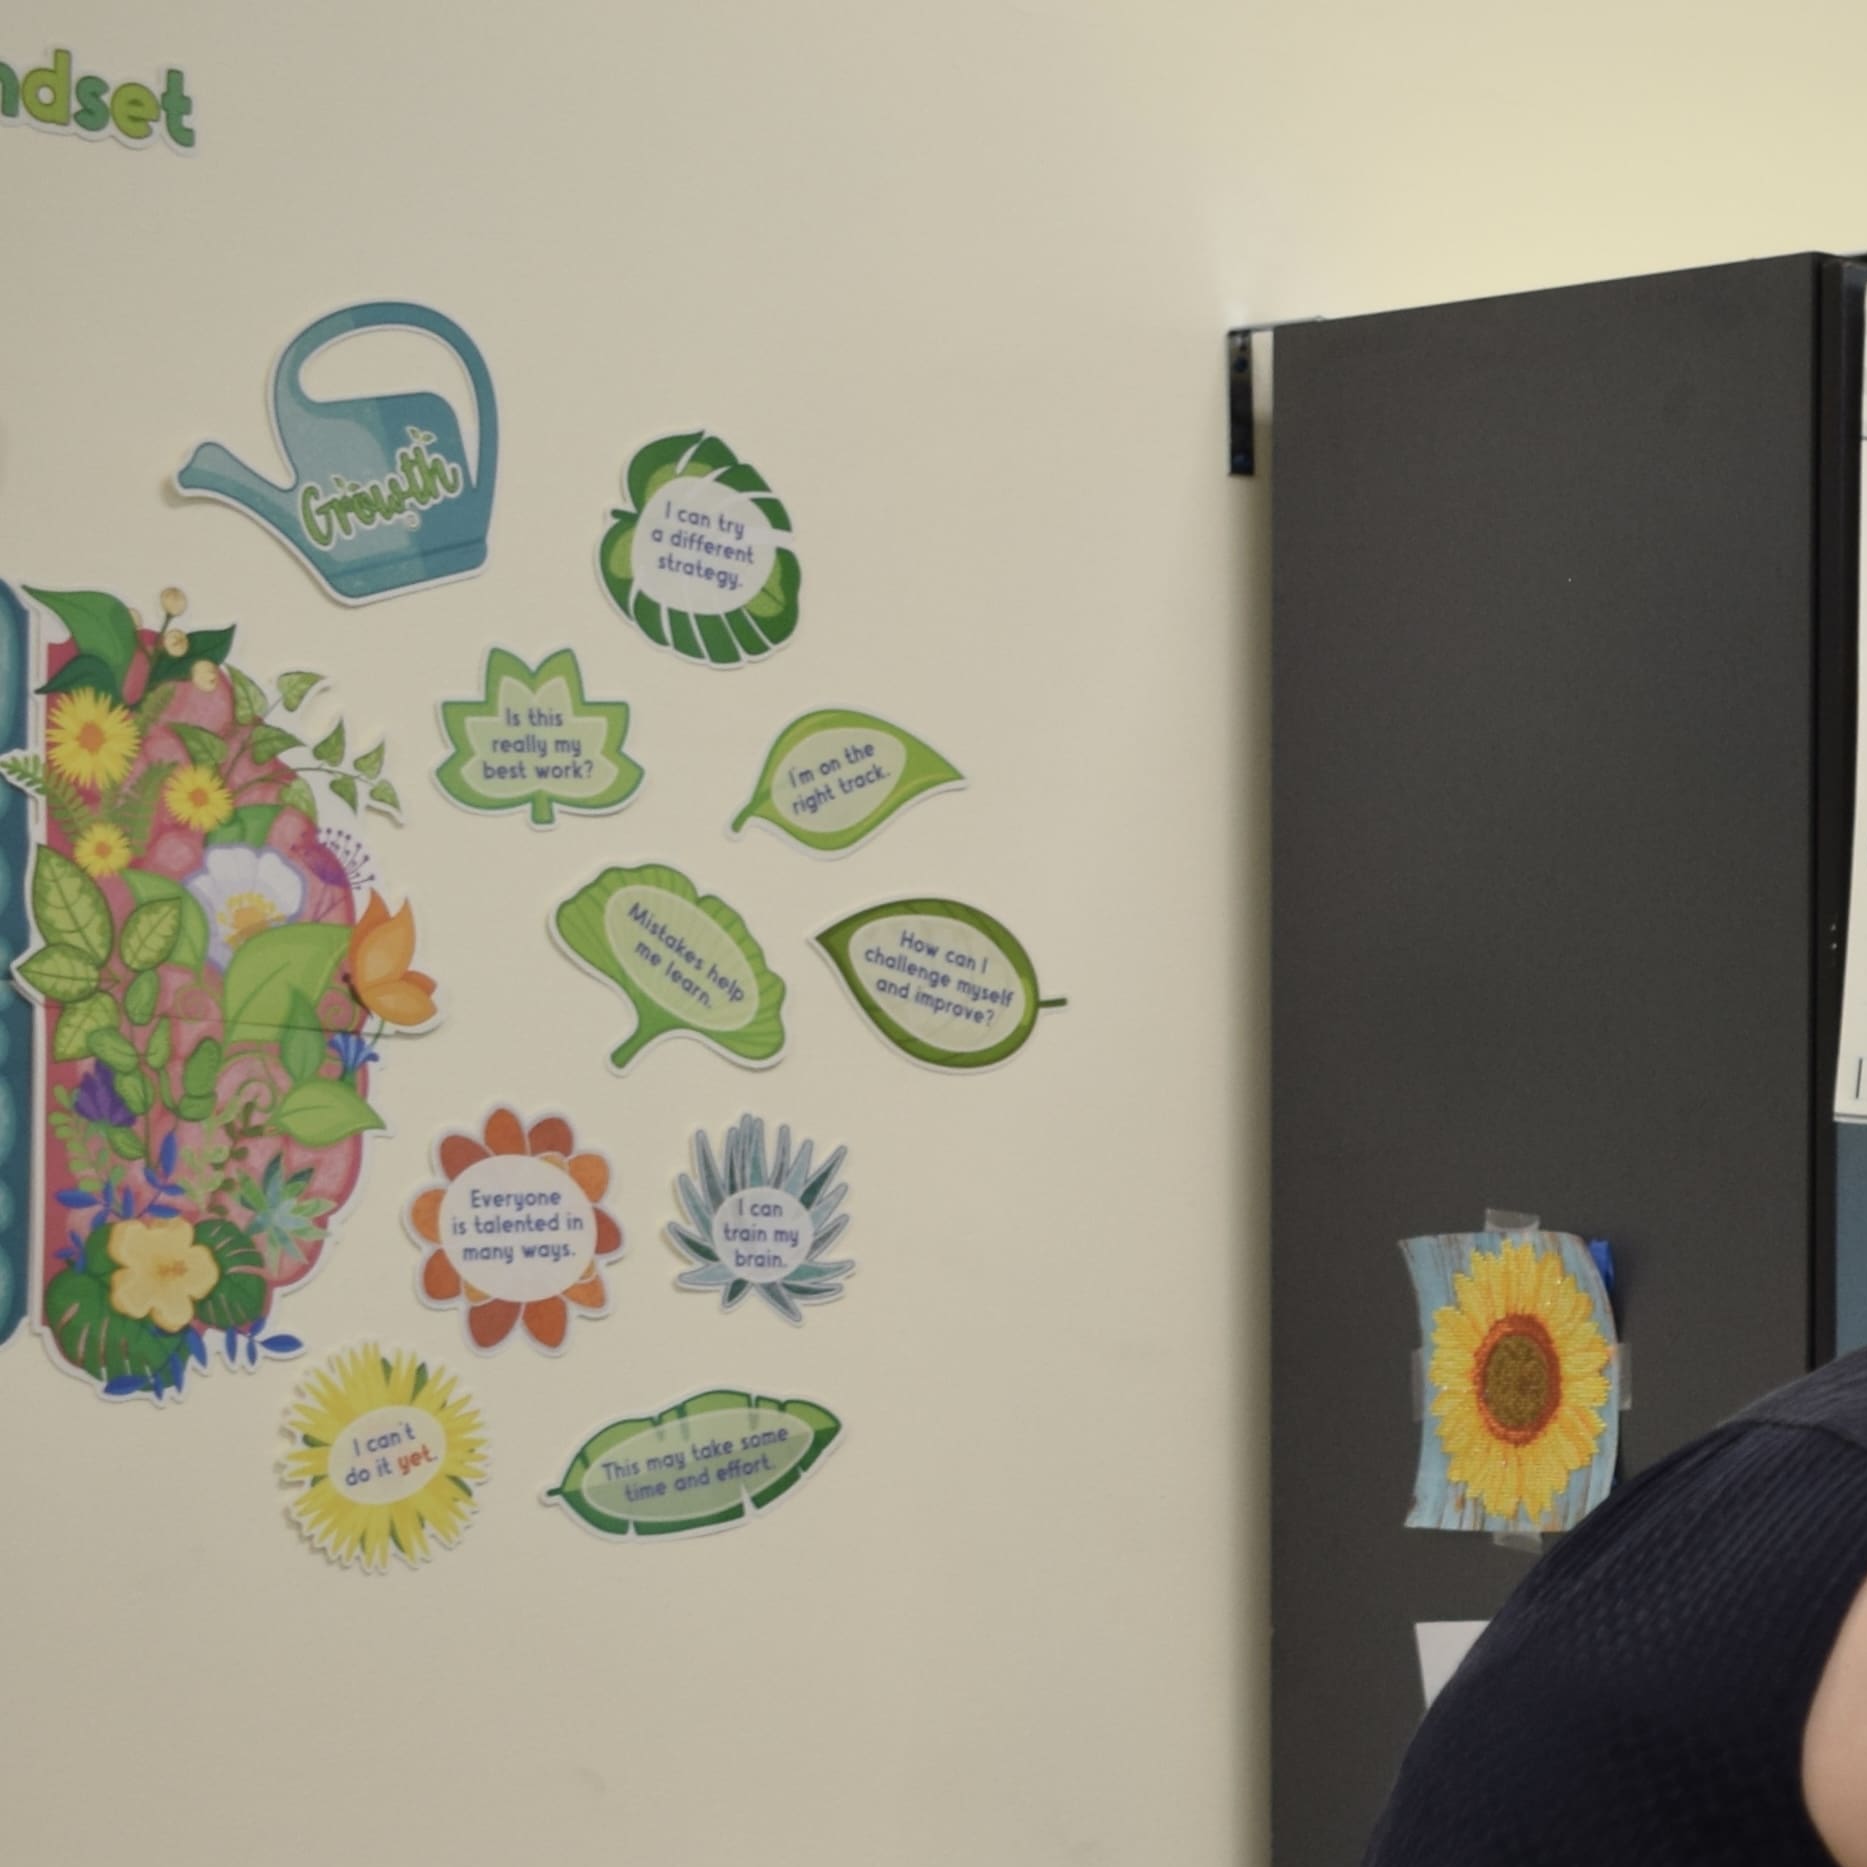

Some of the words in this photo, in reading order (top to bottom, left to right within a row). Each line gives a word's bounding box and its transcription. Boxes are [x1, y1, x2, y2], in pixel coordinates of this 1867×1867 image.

[299, 443, 463, 549] Growth
[664, 500, 672, 520] I
[678, 509, 711, 529] can
[718, 512, 745, 541] try
[651, 528, 664, 543] a
[670, 529, 754, 565] different
[657, 552, 743, 591] strategy.
[505, 707, 521, 728] Is
[527, 707, 564, 728] this
[491, 733, 548, 759] really
[554, 738, 582, 759] my
[818, 758, 841, 776] on
[843, 743, 875, 765] the
[482, 760, 527, 780] best
[535, 759, 594, 780] work?
[792, 783, 836, 816] right
[837, 763, 892, 795] track.
[627, 901, 706, 972] Mistakes
[706, 962, 746, 1003] help
[899, 929, 940, 958] How
[945, 950, 977, 971] can
[980, 956, 989, 975] I
[634, 941, 662, 967] me
[664, 960, 712, 1009] learn.
[863, 946, 952, 989] challenge
[956, 979, 1015, 1008] myself
[875, 979, 911, 999] and
[914, 985, 995, 1027] improve?
[1854, 1058, 1864, 1101] 1
[469, 1188, 563, 1213] Everyone
[737, 1197, 744, 1217] I
[750, 1203, 784, 1218] can
[452, 1215, 468, 1236] is
[474, 1212, 561, 1235] talented
[566, 1211, 584, 1231] in
[723, 1221, 768, 1242] train
[774, 1229, 800, 1249] my
[462, 1245, 515, 1265] many
[520, 1243, 577, 1263] ways.
[734, 1248, 789, 1269] brain.
[352, 1437, 361, 1457] I
[366, 1420, 417, 1453] can't
[601, 1460, 641, 1482] This
[646, 1451, 687, 1471] may
[690, 1439, 734, 1462] take
[741, 1427, 789, 1451] some
[344, 1465, 371, 1487] do
[375, 1455, 393, 1478] it
[396, 1442, 440, 1477] yet.
[624, 1482, 668, 1503] time
[673, 1467, 711, 1492] and
[715, 1452, 777, 1483] effort.
